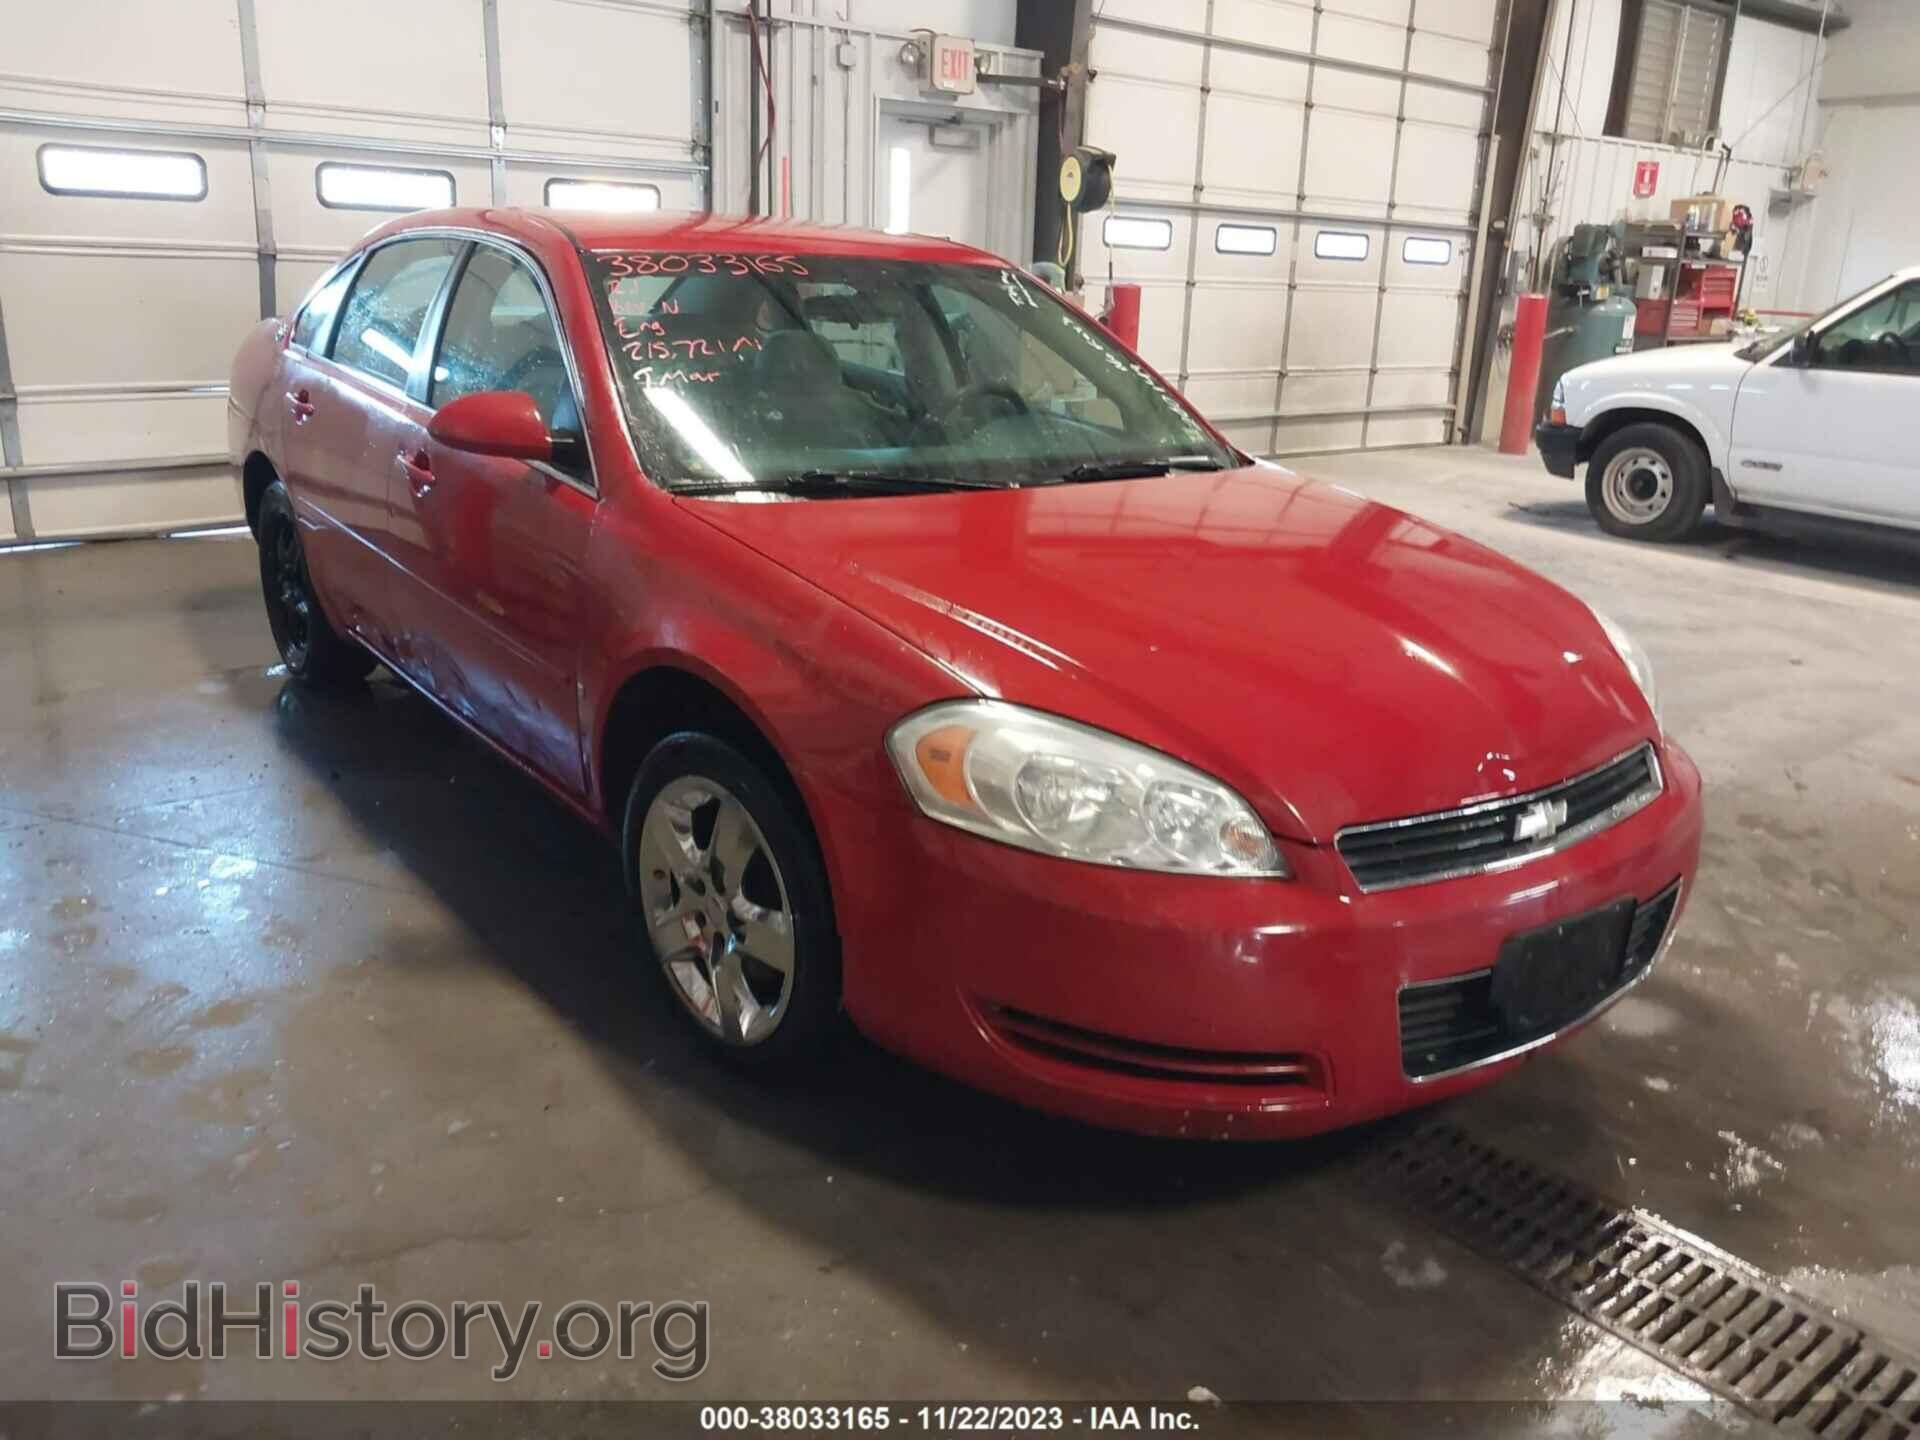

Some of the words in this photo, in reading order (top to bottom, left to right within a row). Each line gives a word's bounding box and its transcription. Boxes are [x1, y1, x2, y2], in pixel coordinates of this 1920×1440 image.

[941, 48, 970, 80] EXIT
[597, 255, 809, 276] 38033165
[614, 316, 666, 338] Eng
